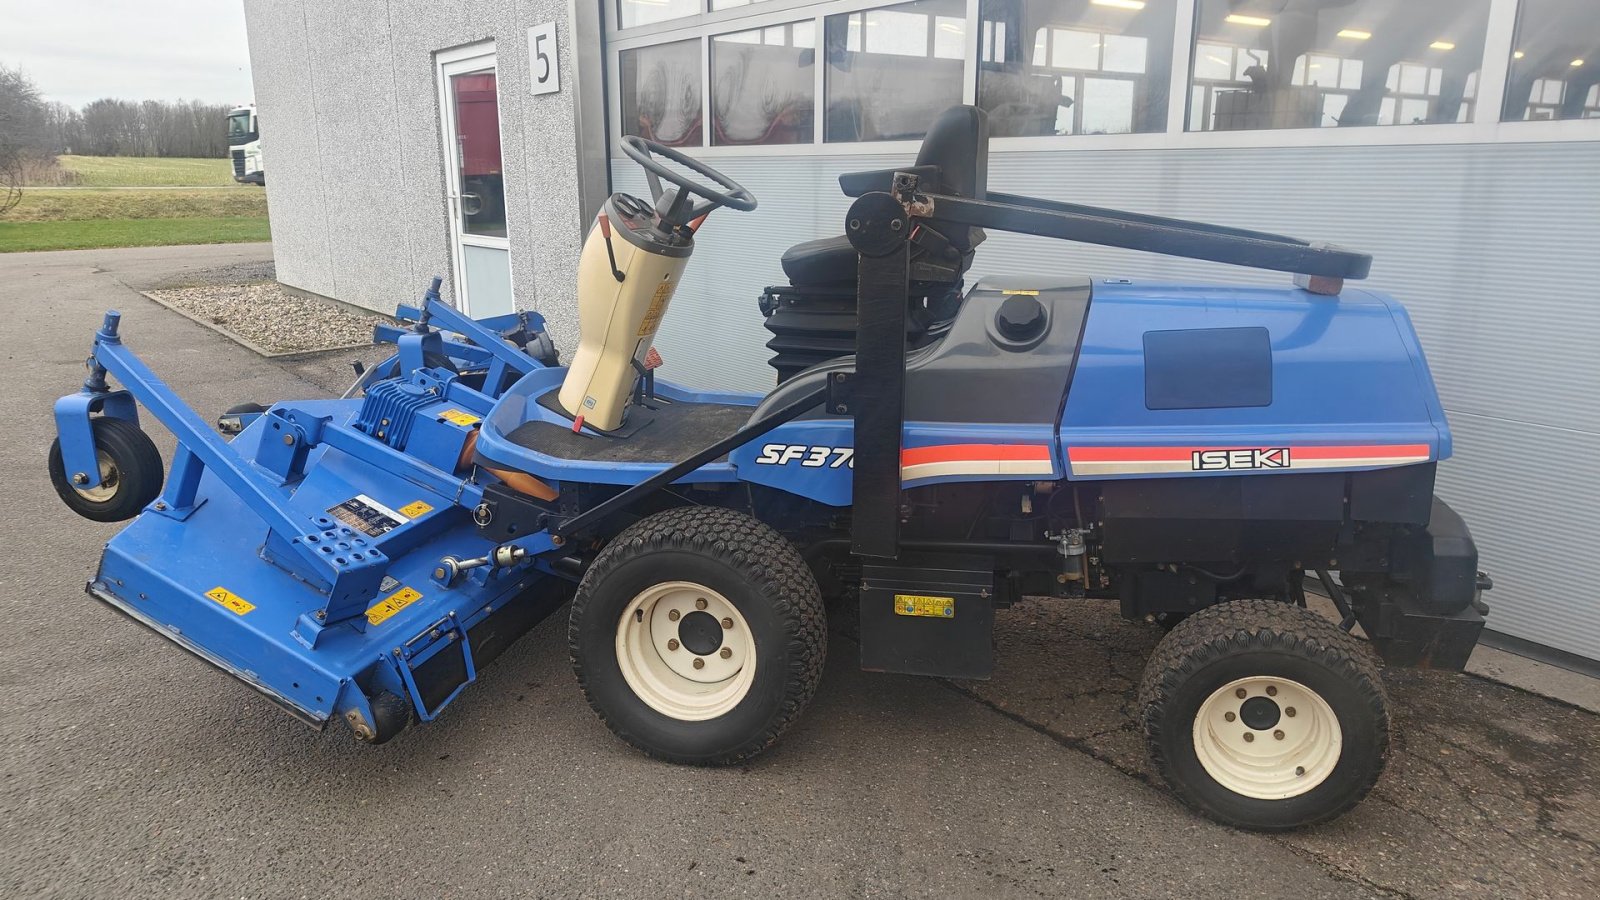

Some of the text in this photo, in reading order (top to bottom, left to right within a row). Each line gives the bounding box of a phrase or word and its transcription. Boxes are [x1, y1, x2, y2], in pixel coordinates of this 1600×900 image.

[536, 34, 549, 83] 5
[755, 443, 854, 469] SF37
[1192, 448, 1290, 470] ISEKI
